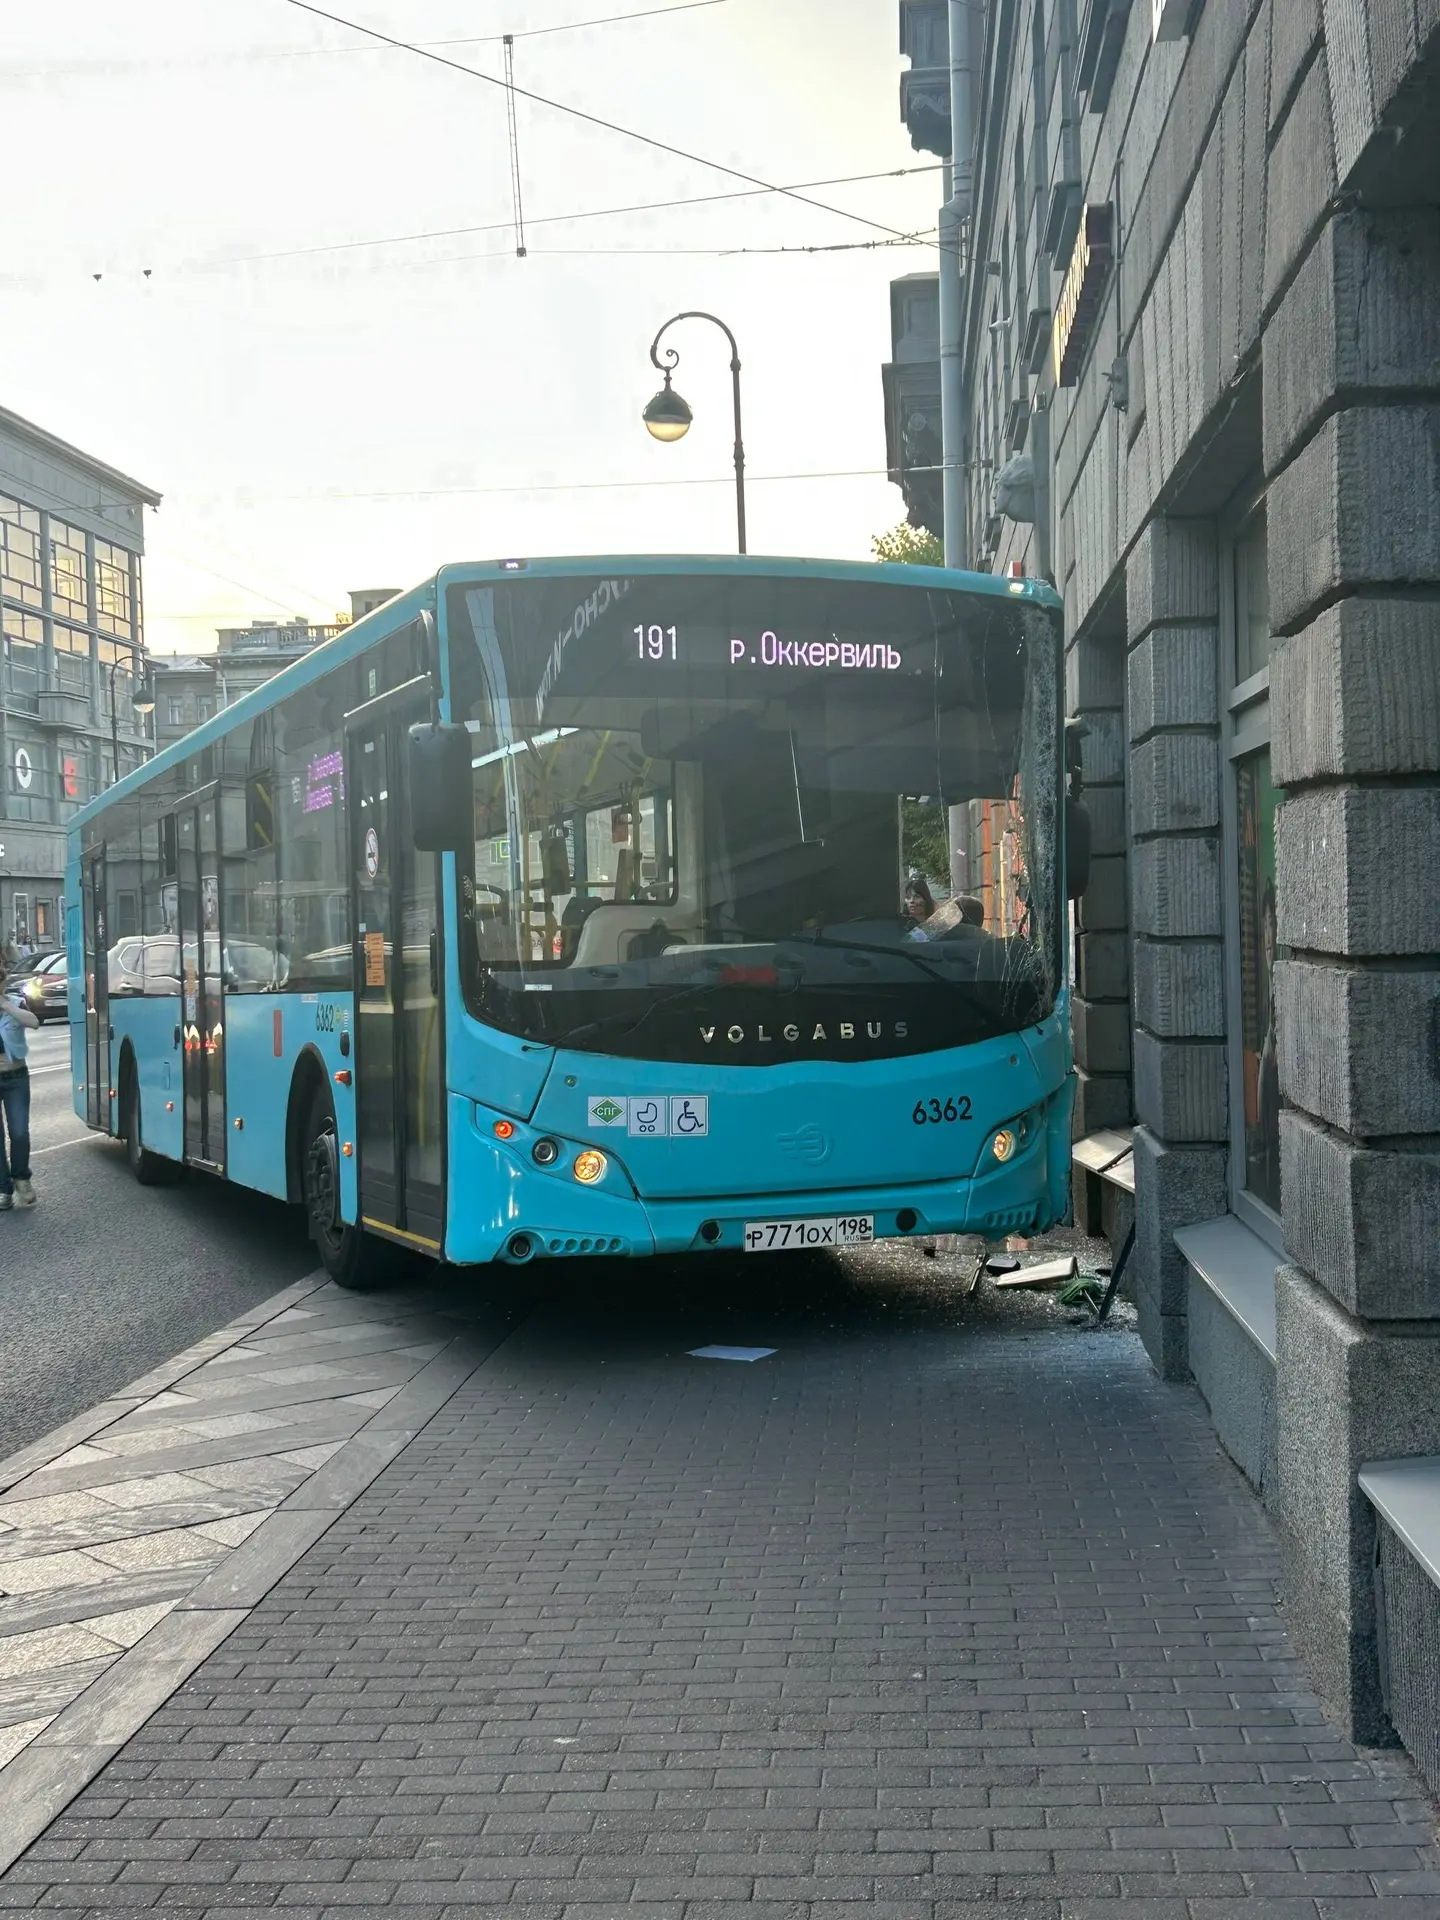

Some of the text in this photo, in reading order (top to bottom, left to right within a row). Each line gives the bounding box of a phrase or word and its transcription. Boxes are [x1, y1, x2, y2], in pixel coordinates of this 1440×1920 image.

[633, 624, 677, 660] 191
[699, 1021, 908, 1044] VOLGABUS
[596, 1107, 618, 1116] СПГ
[912, 1095, 973, 1126] 6362
[838, 1218, 868, 1236] 198
[844, 1233, 860, 1242] RUS
